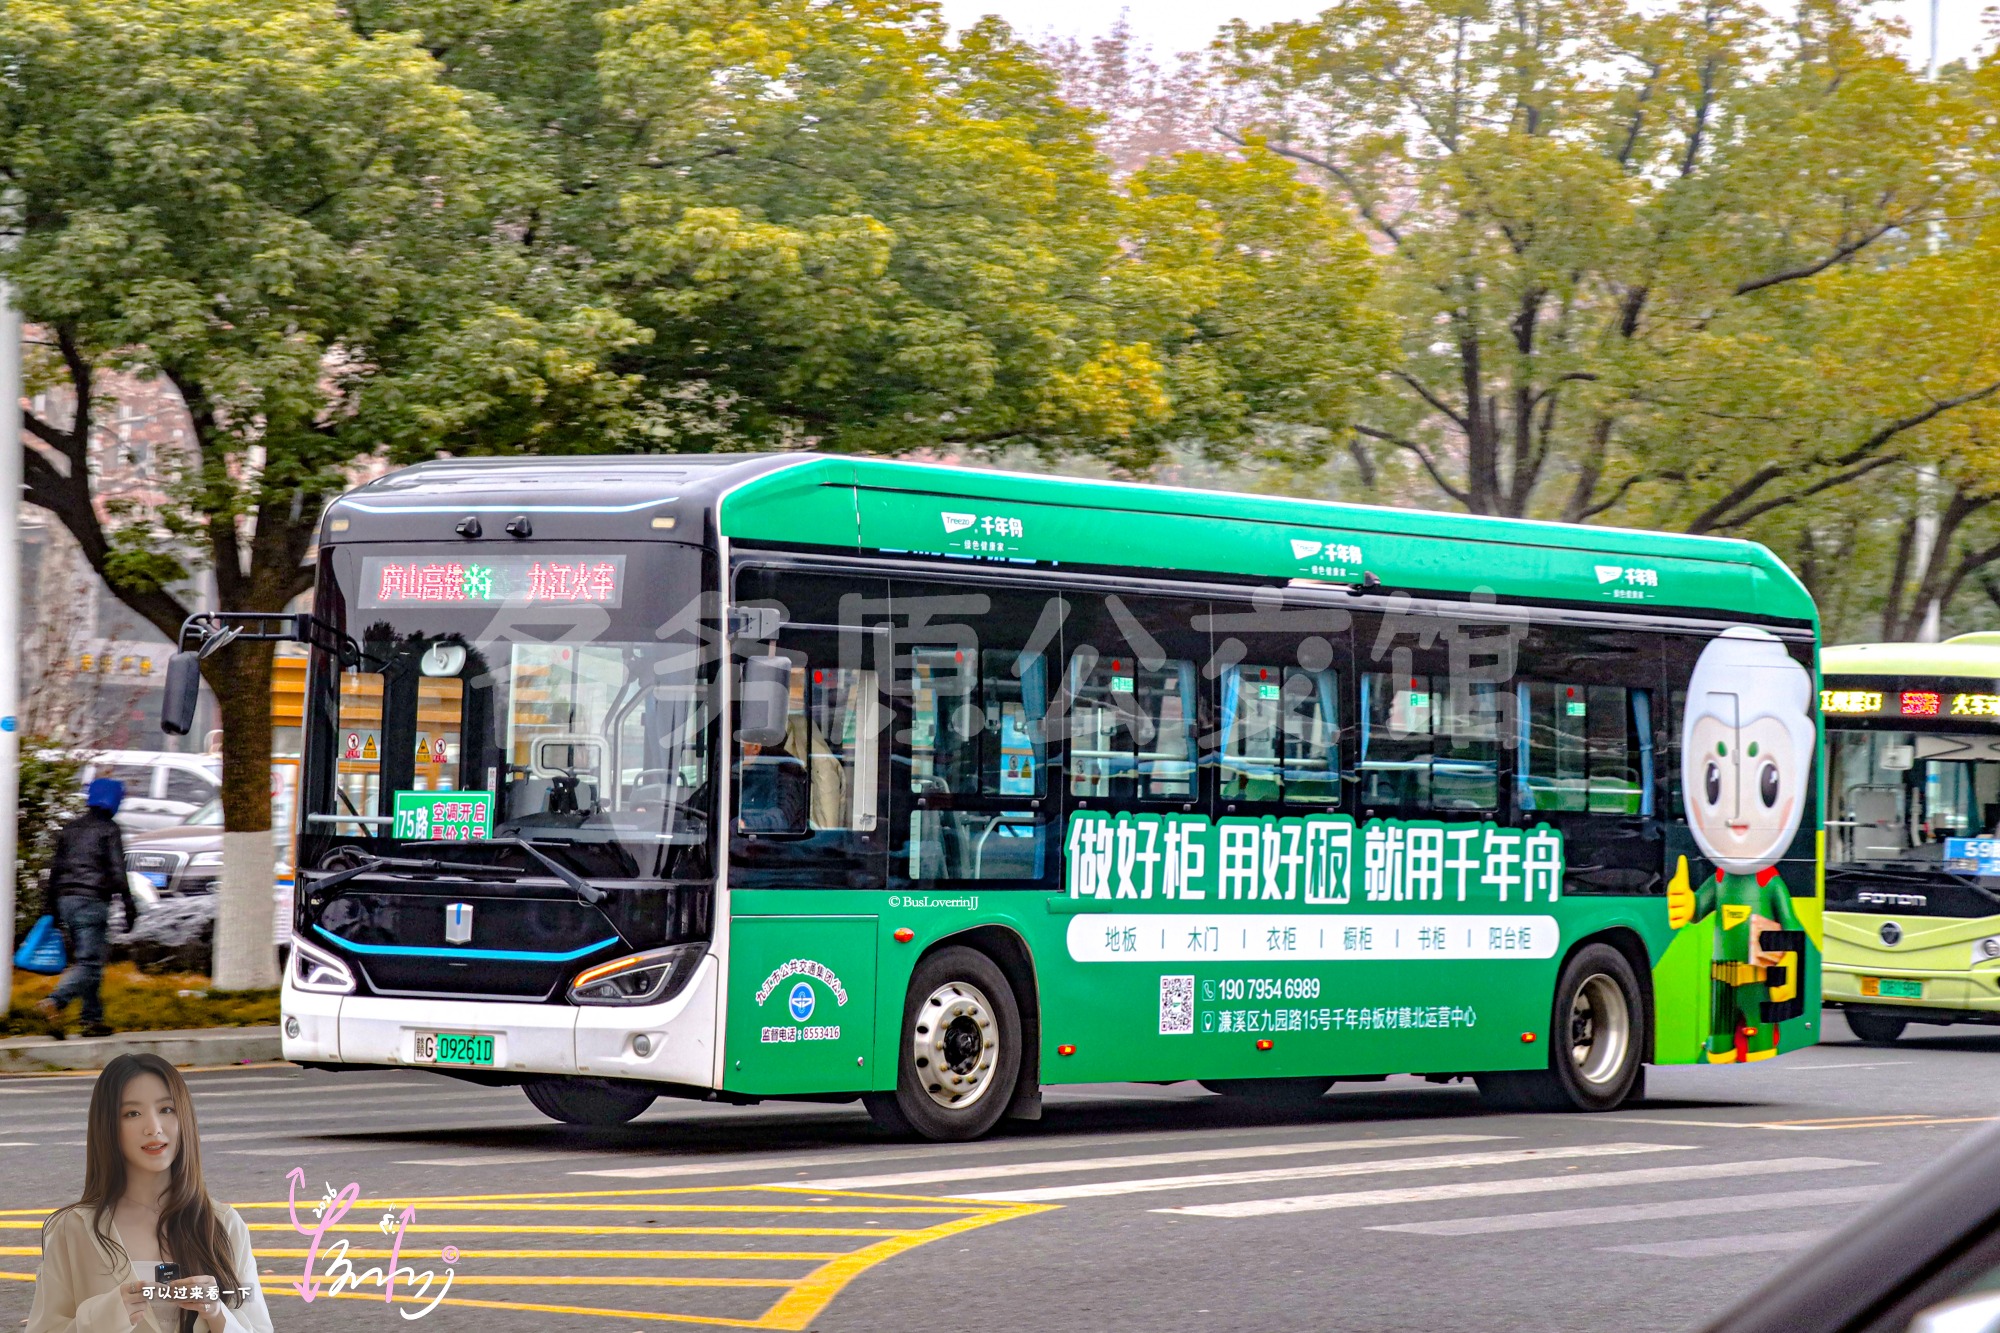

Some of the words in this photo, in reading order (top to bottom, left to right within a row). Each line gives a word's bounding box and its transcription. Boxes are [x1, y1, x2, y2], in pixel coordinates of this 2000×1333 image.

[946, 516, 970, 526] Treezo
[981, 515, 1023, 538] 千年舟
[399, 807, 429, 839] 75路
[433, 802, 487, 822] 空调开启
[1069, 817, 1207, 901] 做好柜
[1218, 820, 1352, 905] 用好板
[1364, 824, 1562, 904] 就用千年舟
[1105, 926, 1138, 953] 地板
[1187, 926, 1219, 952] 木门
[1266, 926, 1297, 952] 衣柜
[1342, 926, 1373, 951] 橱柜
[1417, 926, 1447, 951] 书柜
[1488, 926, 1532, 951] 阳台柜
[755, 959, 848, 1006] 九江市公共交通集团公司
[1218, 979, 1245, 1000] 190
[1247, 978, 1283, 1000] 7954
[1284, 977, 1320, 999] 6989
